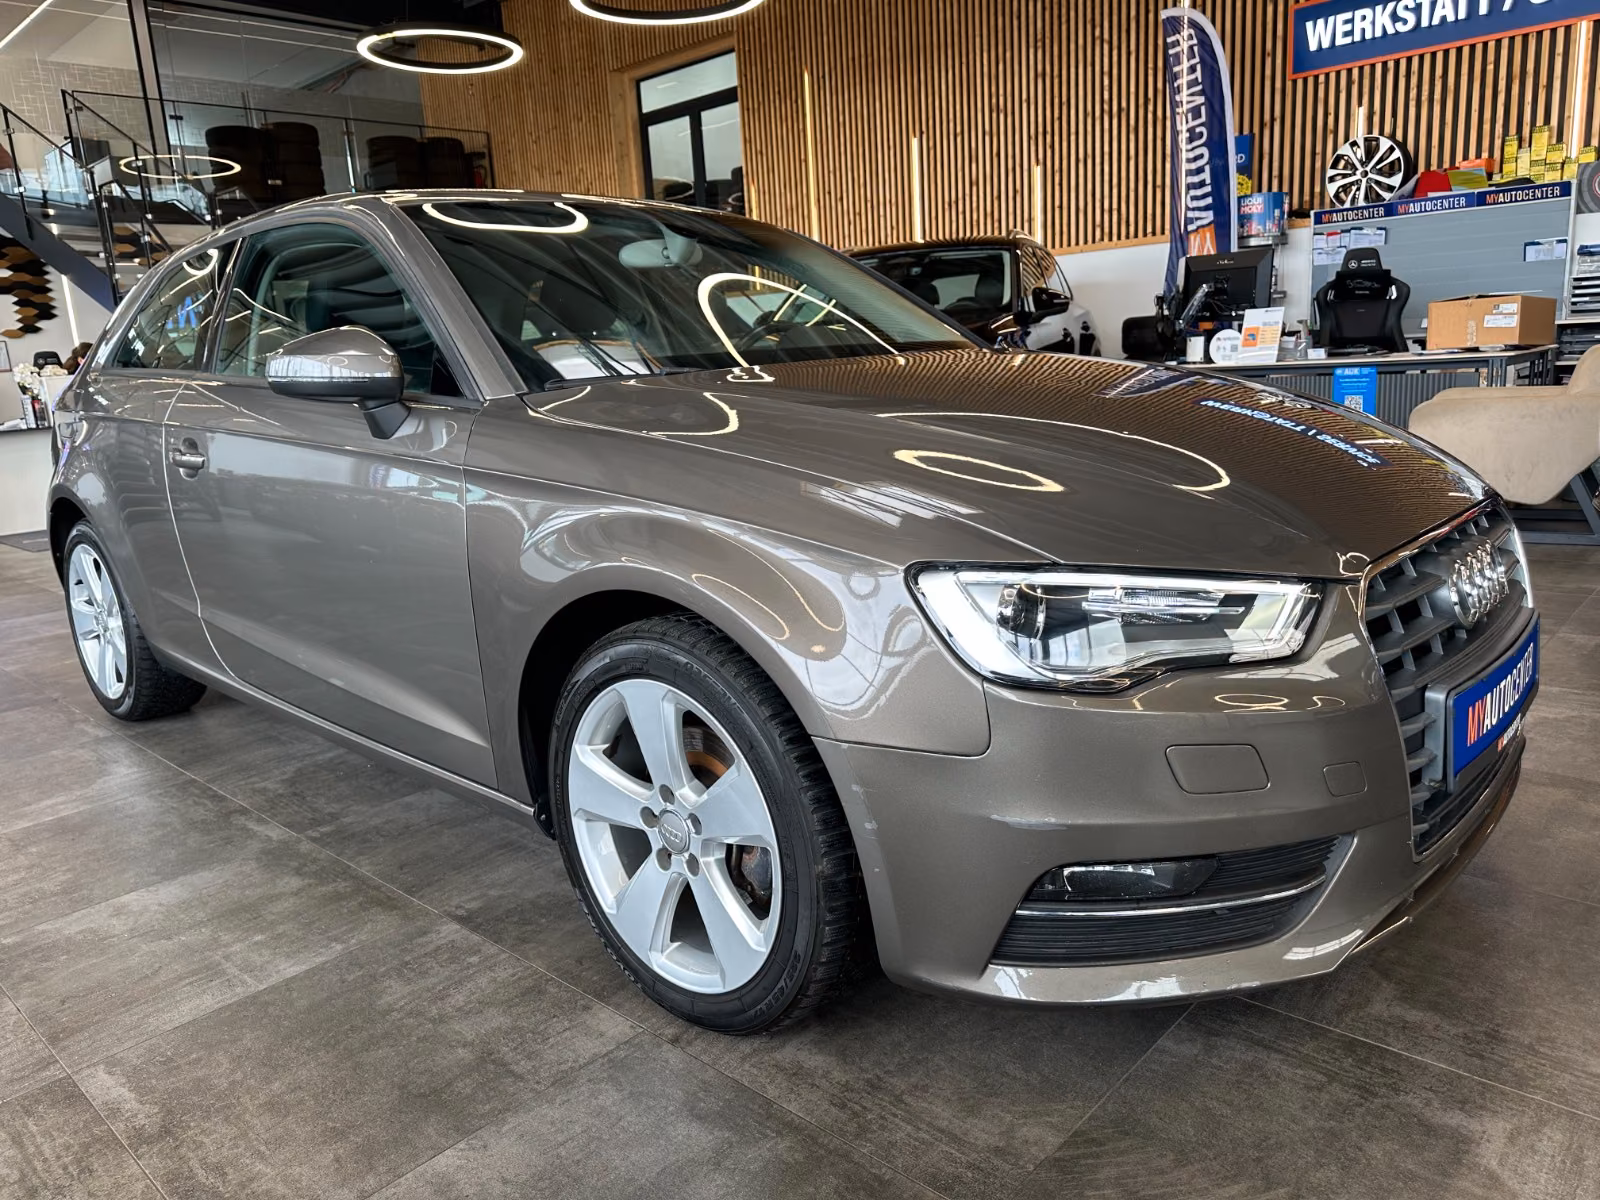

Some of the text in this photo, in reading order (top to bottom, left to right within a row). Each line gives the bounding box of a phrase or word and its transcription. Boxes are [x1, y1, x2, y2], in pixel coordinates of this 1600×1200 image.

[1486, 186, 1560, 204] MYAUTOCENTER
[1398, 197, 1466, 214] MYAUTOCENTER
[1322, 207, 1385, 223] MYAUTOCENTER
[1467, 642, 1533, 747] MYAUTOCENTER
